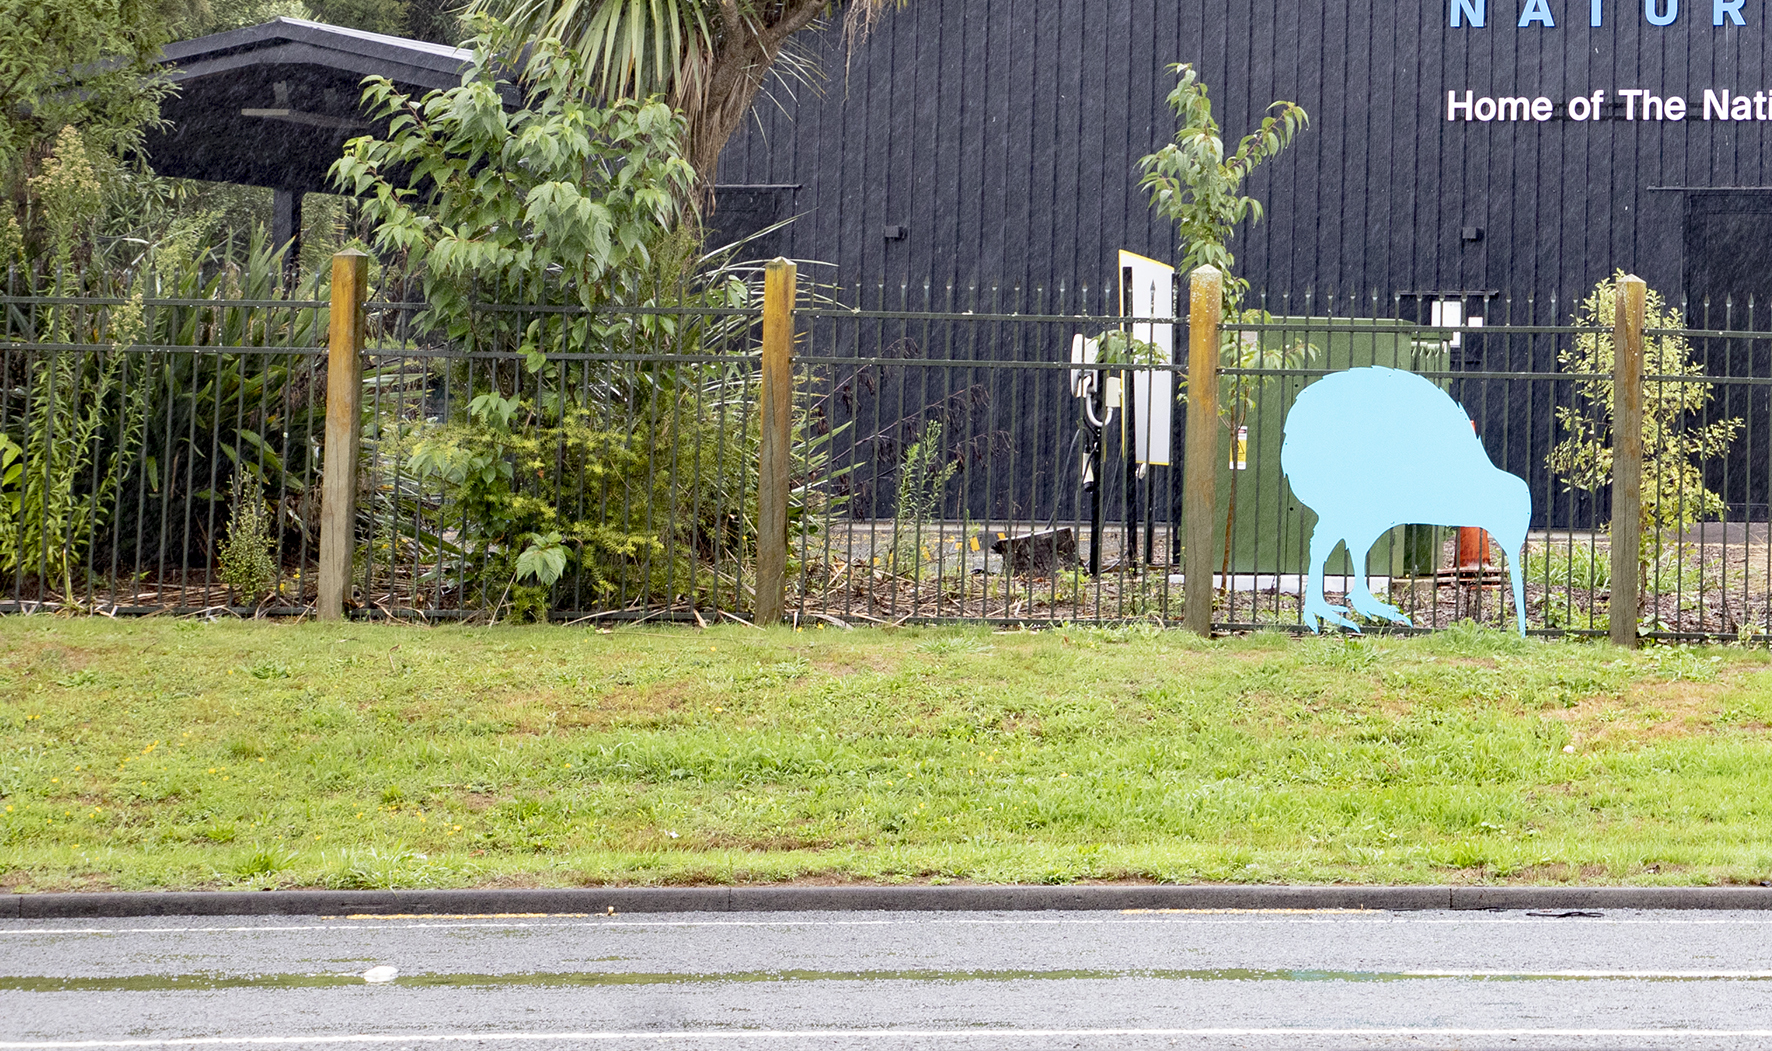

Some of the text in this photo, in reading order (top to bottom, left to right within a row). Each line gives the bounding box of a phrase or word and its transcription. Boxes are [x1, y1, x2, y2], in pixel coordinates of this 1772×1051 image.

[1447, 89, 1553, 122] Home
[1568, 89, 1605, 121] of
[1618, 89, 1687, 121] The
